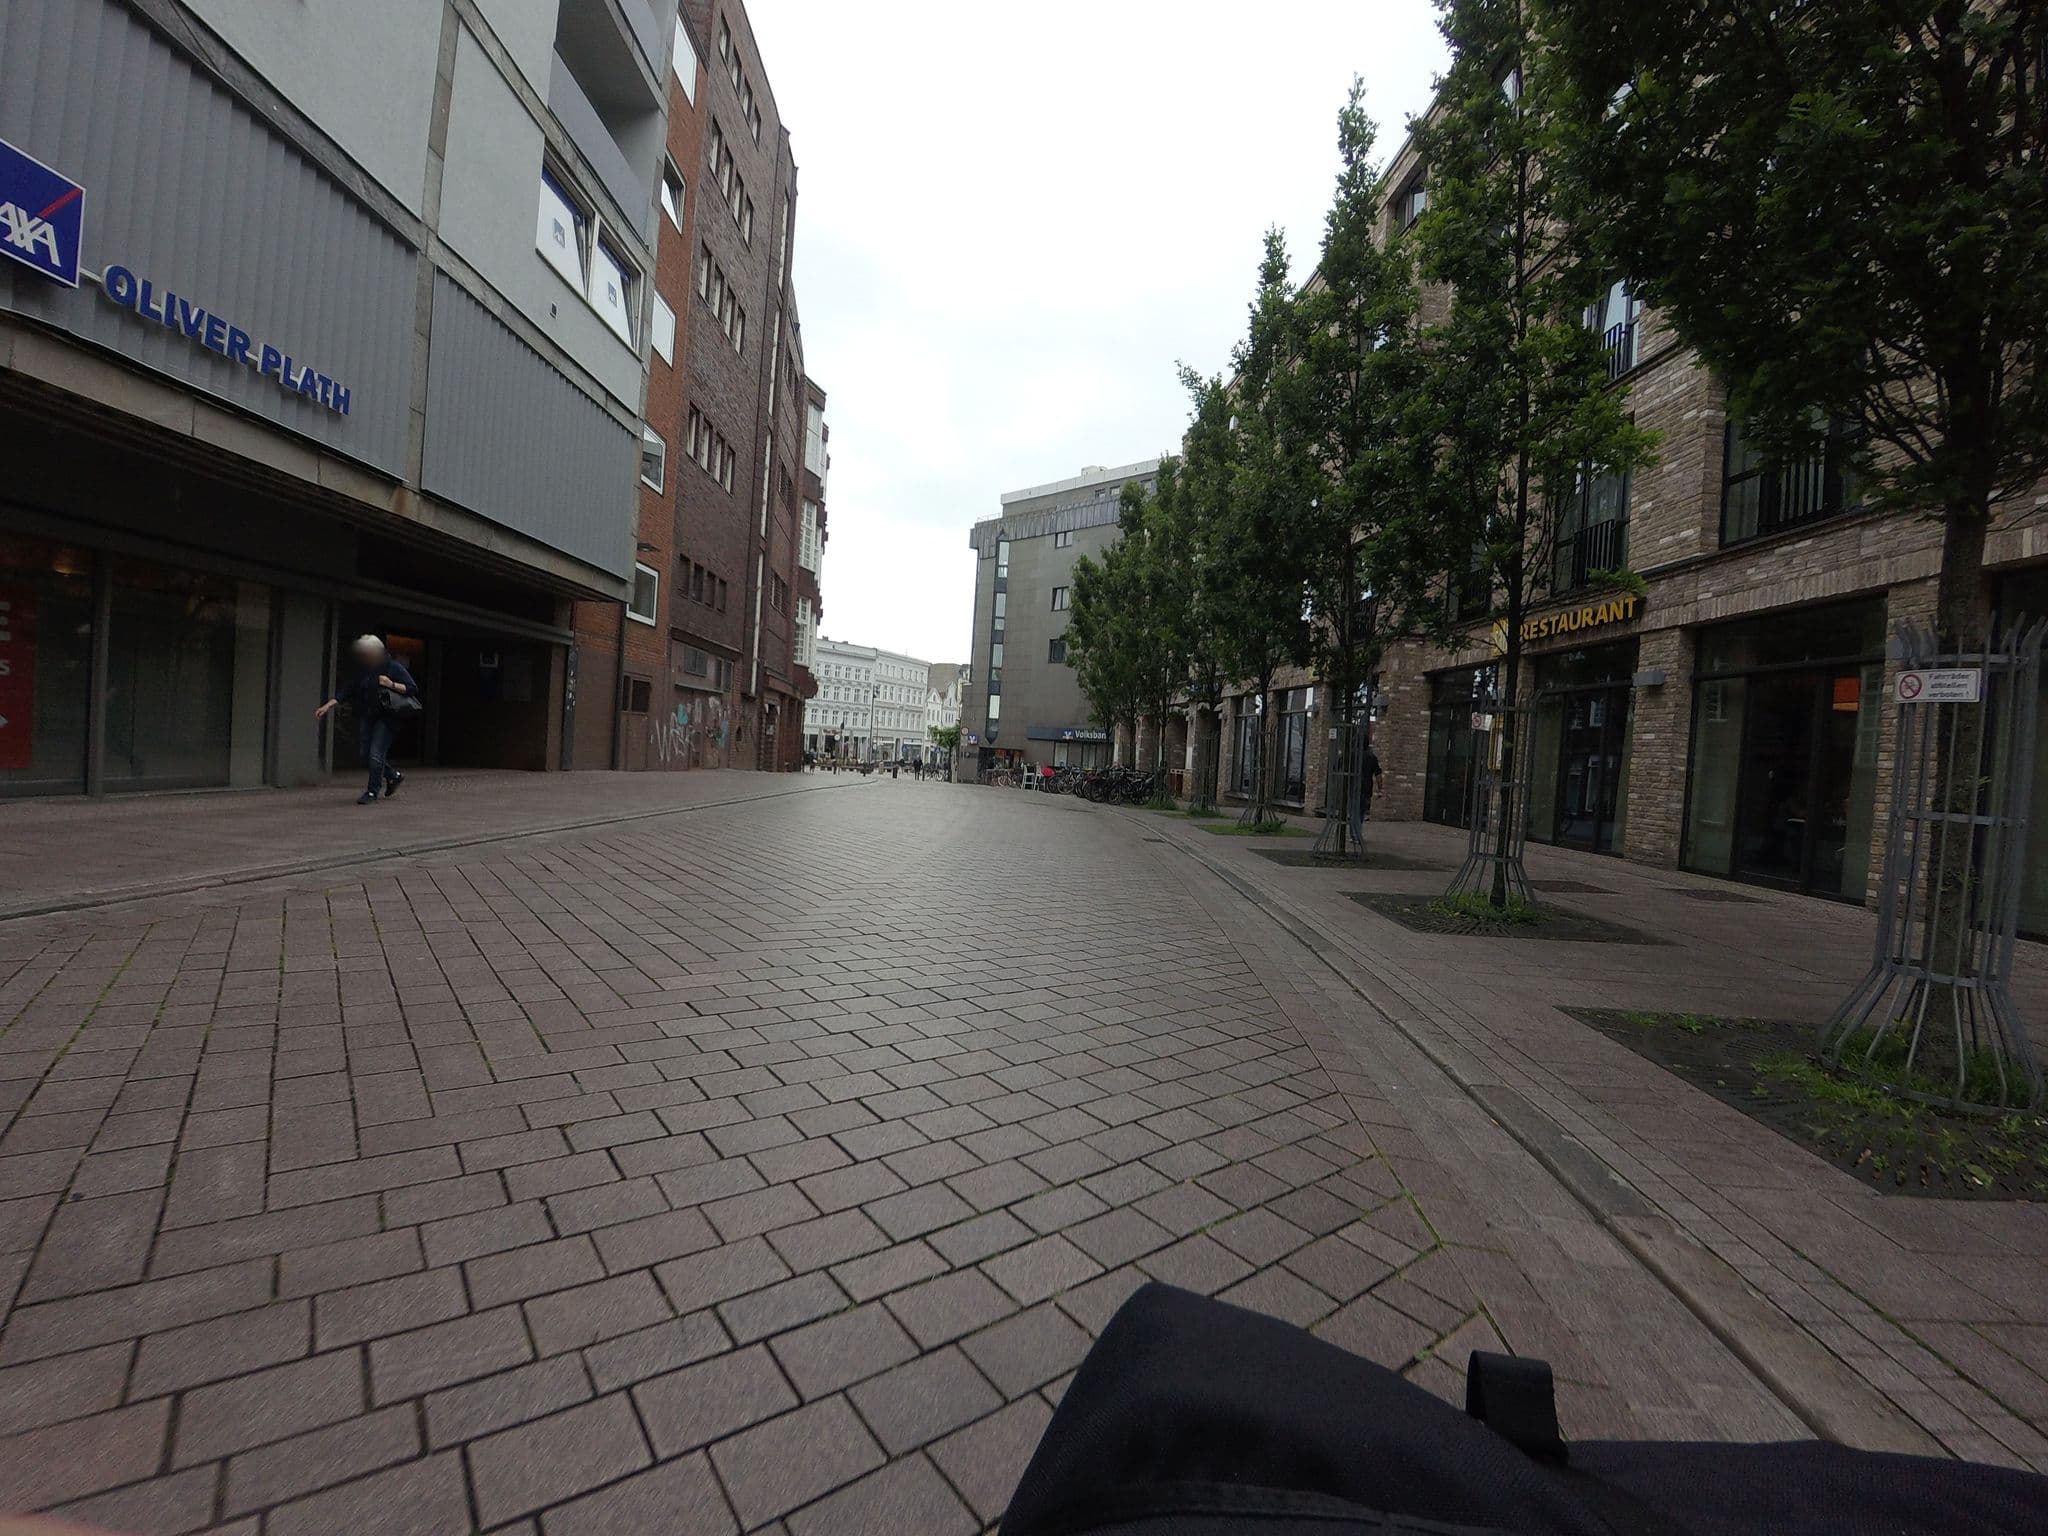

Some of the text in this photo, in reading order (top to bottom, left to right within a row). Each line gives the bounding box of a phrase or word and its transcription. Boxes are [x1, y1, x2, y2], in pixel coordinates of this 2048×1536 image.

[0, 202, 61, 267] AXA
[102, 264, 351, 415] OLIVER PLATH
[1519, 597, 1637, 641] RESTAURANT
[1074, 730, 1106, 740] Volksban
